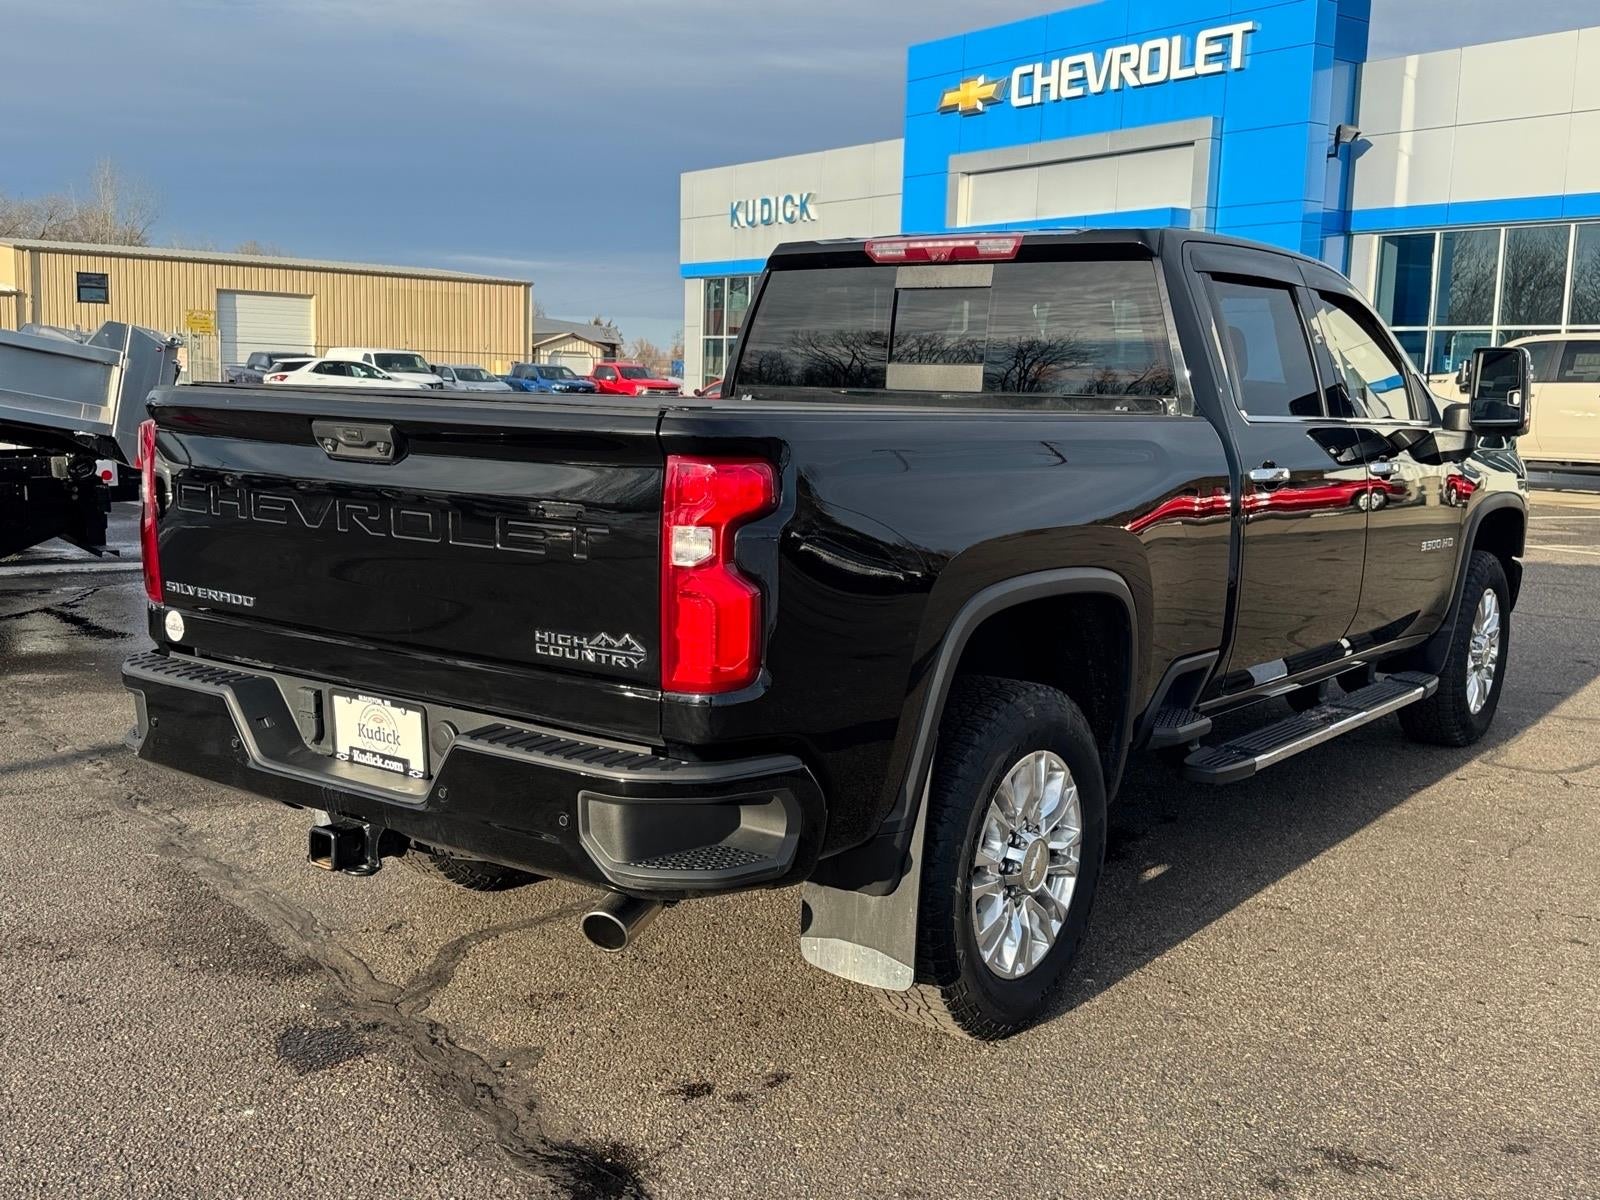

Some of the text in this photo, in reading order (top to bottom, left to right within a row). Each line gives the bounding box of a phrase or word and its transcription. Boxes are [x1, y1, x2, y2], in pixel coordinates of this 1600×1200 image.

[1010, 20, 1256, 109] CHEVROLET
[730, 192, 816, 229] KUDICK
[176, 481, 610, 561] CHEVROLET
[165, 580, 256, 607] SILVERADO
[535, 630, 588, 648] HIGH
[535, 643, 646, 669] COUNTRY
[357, 722, 401, 746] Kudick
[353, 749, 404, 772] Kudick.com
